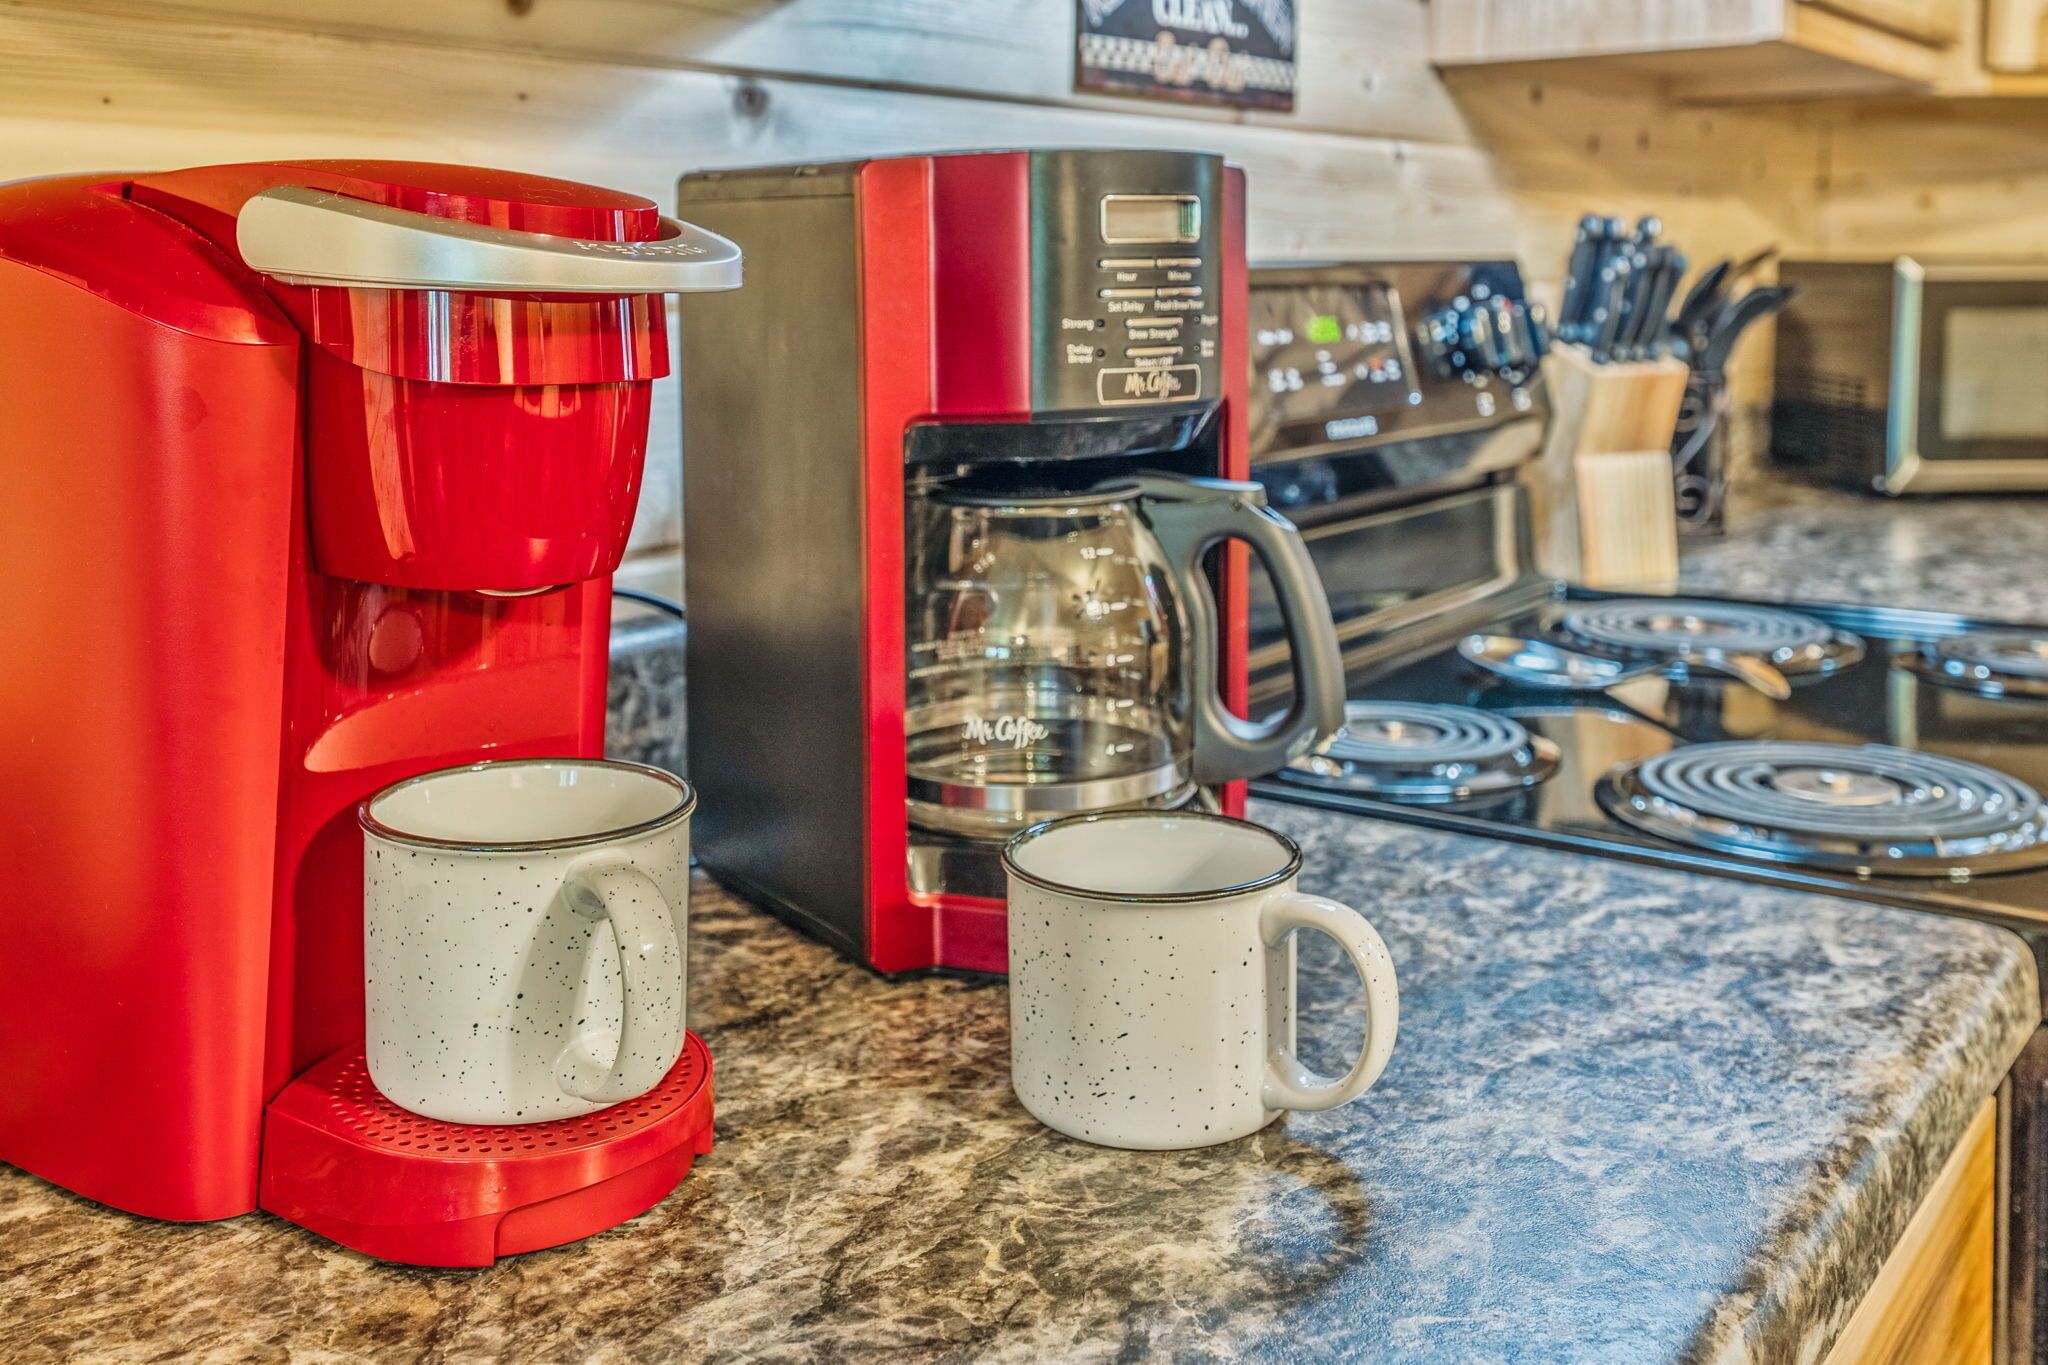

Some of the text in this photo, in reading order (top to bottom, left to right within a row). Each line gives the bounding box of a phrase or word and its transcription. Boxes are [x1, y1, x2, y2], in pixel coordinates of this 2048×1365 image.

[1116, 271, 1138, 282] Hour
[1108, 301, 1145, 313] Set Delay
[1062, 318, 1094, 331] Strong
[1129, 329, 1148, 340] Brew
[1066, 343, 1094, 355] Delay
[1068, 354, 1093, 364] Brew
[1146, 370, 1182, 401] Coffee
[995, 715, 1050, 750] Coffee
